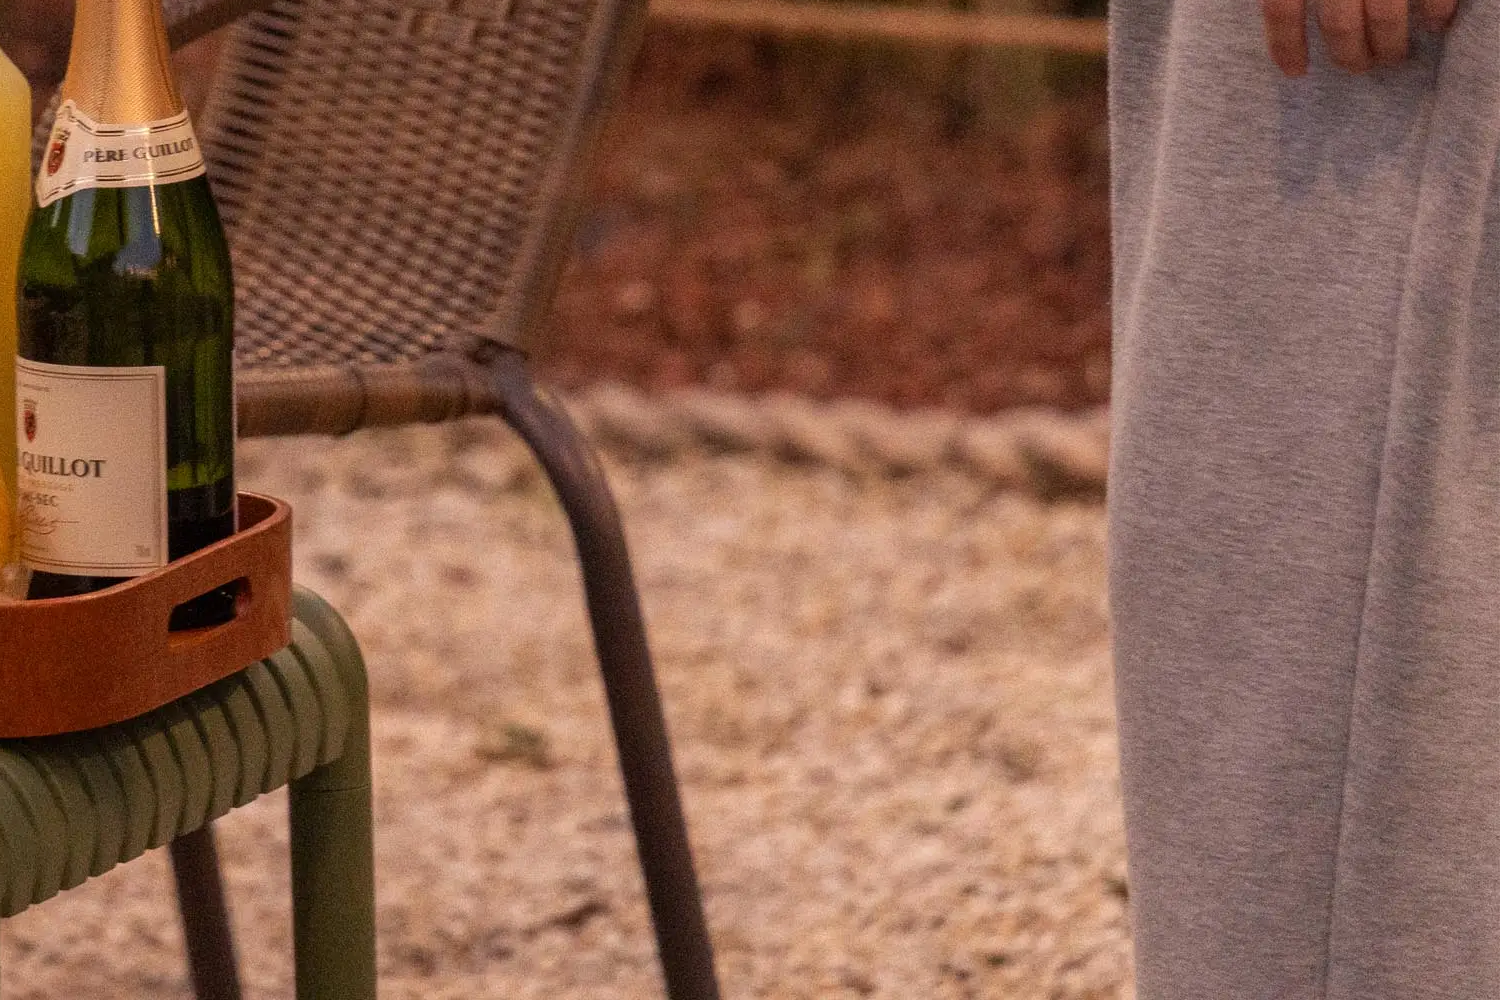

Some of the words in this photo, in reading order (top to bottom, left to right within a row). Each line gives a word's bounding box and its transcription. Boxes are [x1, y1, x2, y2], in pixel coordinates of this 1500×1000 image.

[83, 147, 129, 163] PÈRE
[132, 137, 194, 161] GUILLOT
[21, 451, 106, 478] GUILLOT
